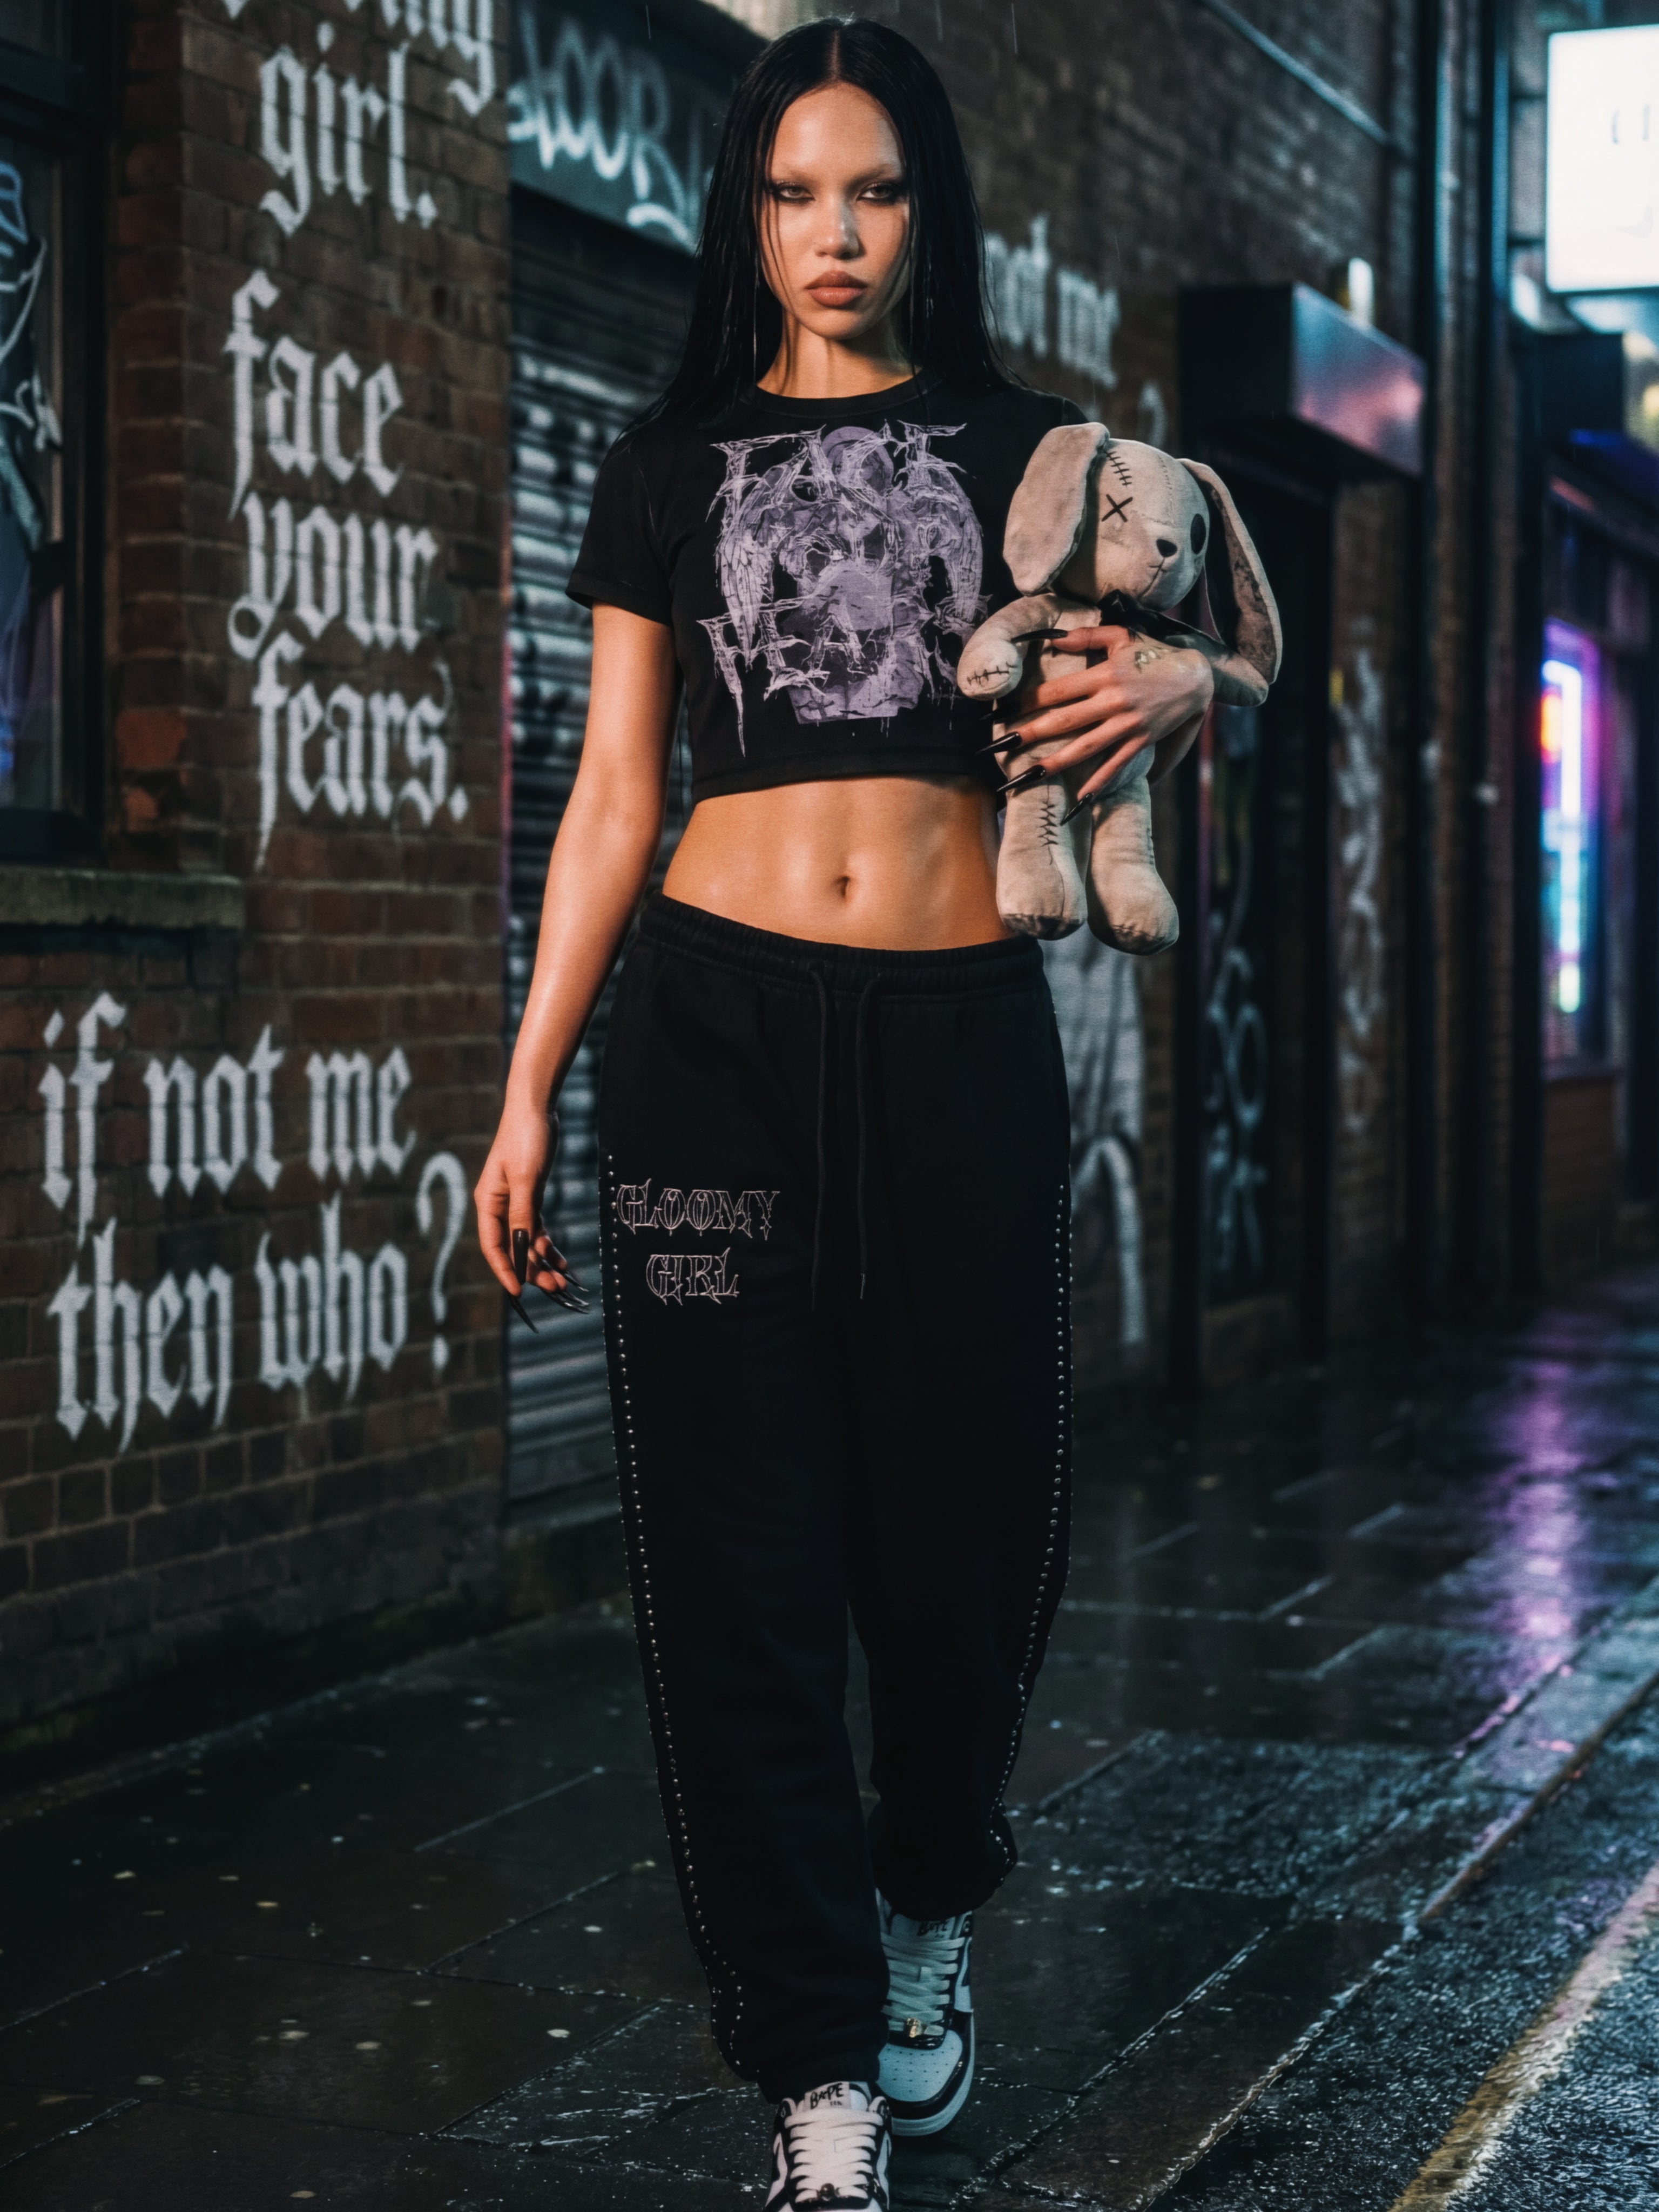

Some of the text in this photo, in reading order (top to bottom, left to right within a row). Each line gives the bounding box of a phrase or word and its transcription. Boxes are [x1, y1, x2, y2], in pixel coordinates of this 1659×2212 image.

[259, 21, 436, 237] girl.
[222, 267, 404, 523] face
[227, 490, 439, 662] your
[251, 631, 468, 873] fears.
[38, 992, 416, 1249] if not me
[617, 1178, 780, 1240] GLOOMY
[47, 1152, 467, 1454] then who?
[646, 1246, 740, 1306] GIRL
